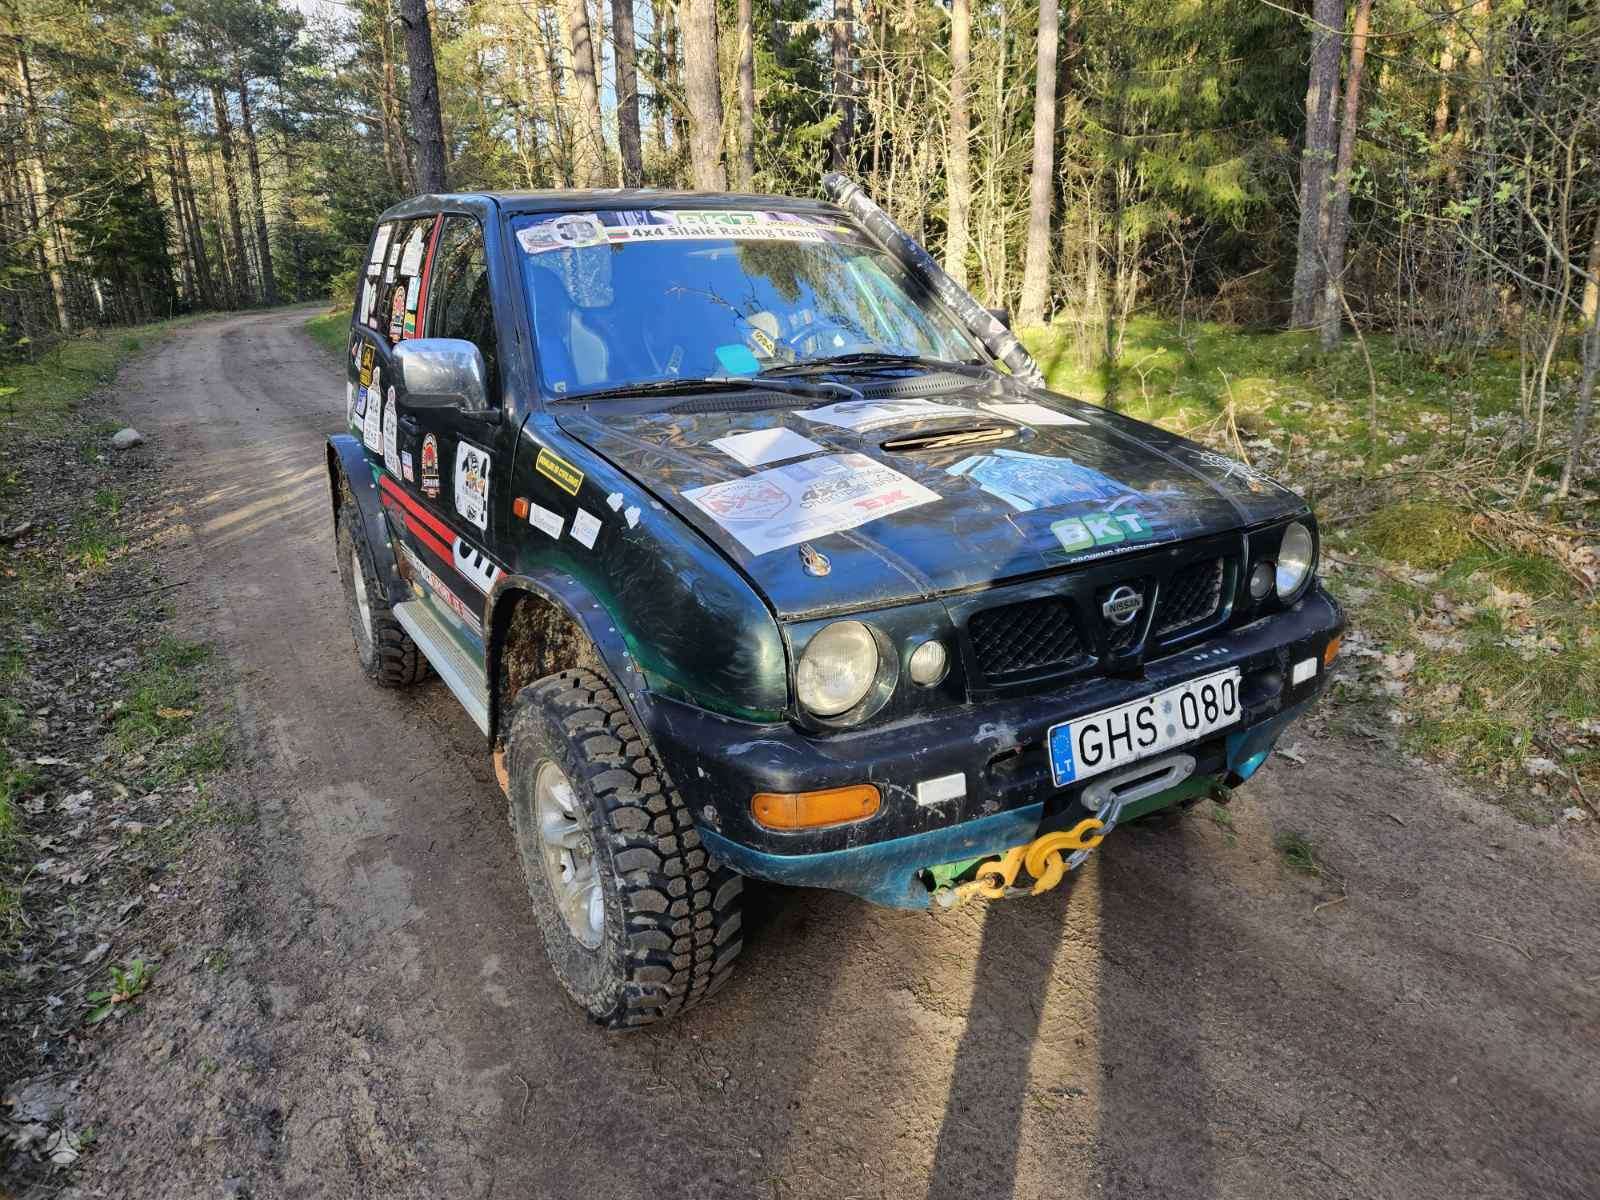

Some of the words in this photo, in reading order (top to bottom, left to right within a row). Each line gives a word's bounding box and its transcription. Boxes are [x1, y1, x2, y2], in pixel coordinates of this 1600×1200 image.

[632, 227, 664, 237] 4x4
[720, 226, 776, 239] Racing
[780, 228, 818, 239] Team
[1053, 512, 1144, 544] BKT
[1109, 599, 1141, 612] NISSAN
[1079, 706, 1157, 766] GHS
[1180, 679, 1236, 730] 080
[1056, 758, 1072, 775] LT
